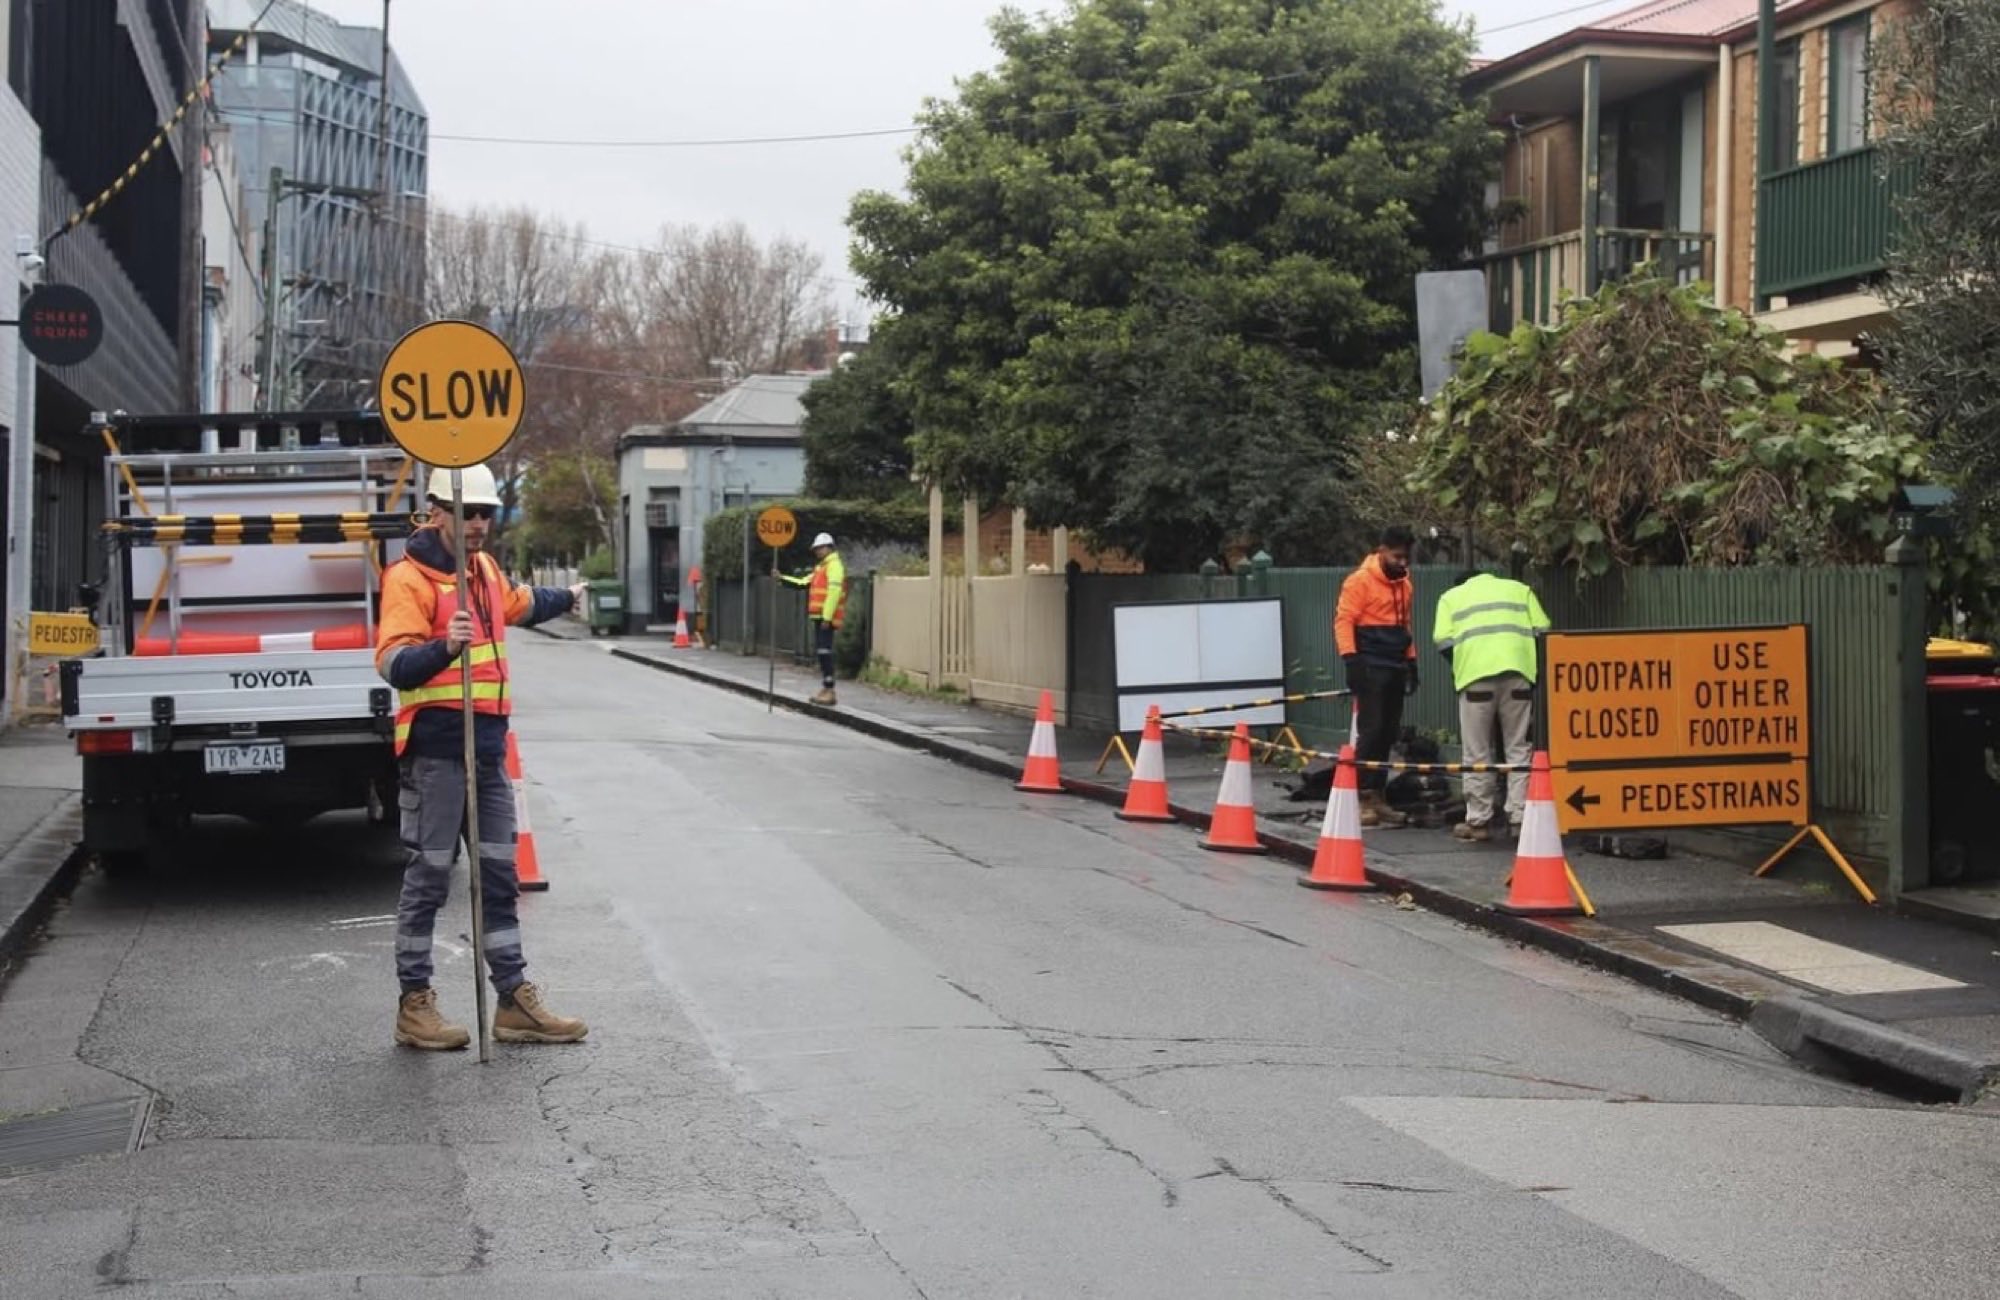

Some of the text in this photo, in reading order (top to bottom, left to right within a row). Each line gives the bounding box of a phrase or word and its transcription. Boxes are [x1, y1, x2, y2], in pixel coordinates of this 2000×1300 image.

[390, 368, 513, 422] SLOW
[759, 519, 793, 534] SLOW
[1713, 641, 1769, 671] USE
[229, 670, 313, 689] TOYOTA
[1553, 659, 1672, 693] FOOTPATH
[1695, 678, 1790, 710] OTHER
[1568, 706, 1659, 740] CLOSED
[1688, 715, 1798, 747] FOOTPATH
[1621, 778, 1800, 813] PEDESTRIANS
